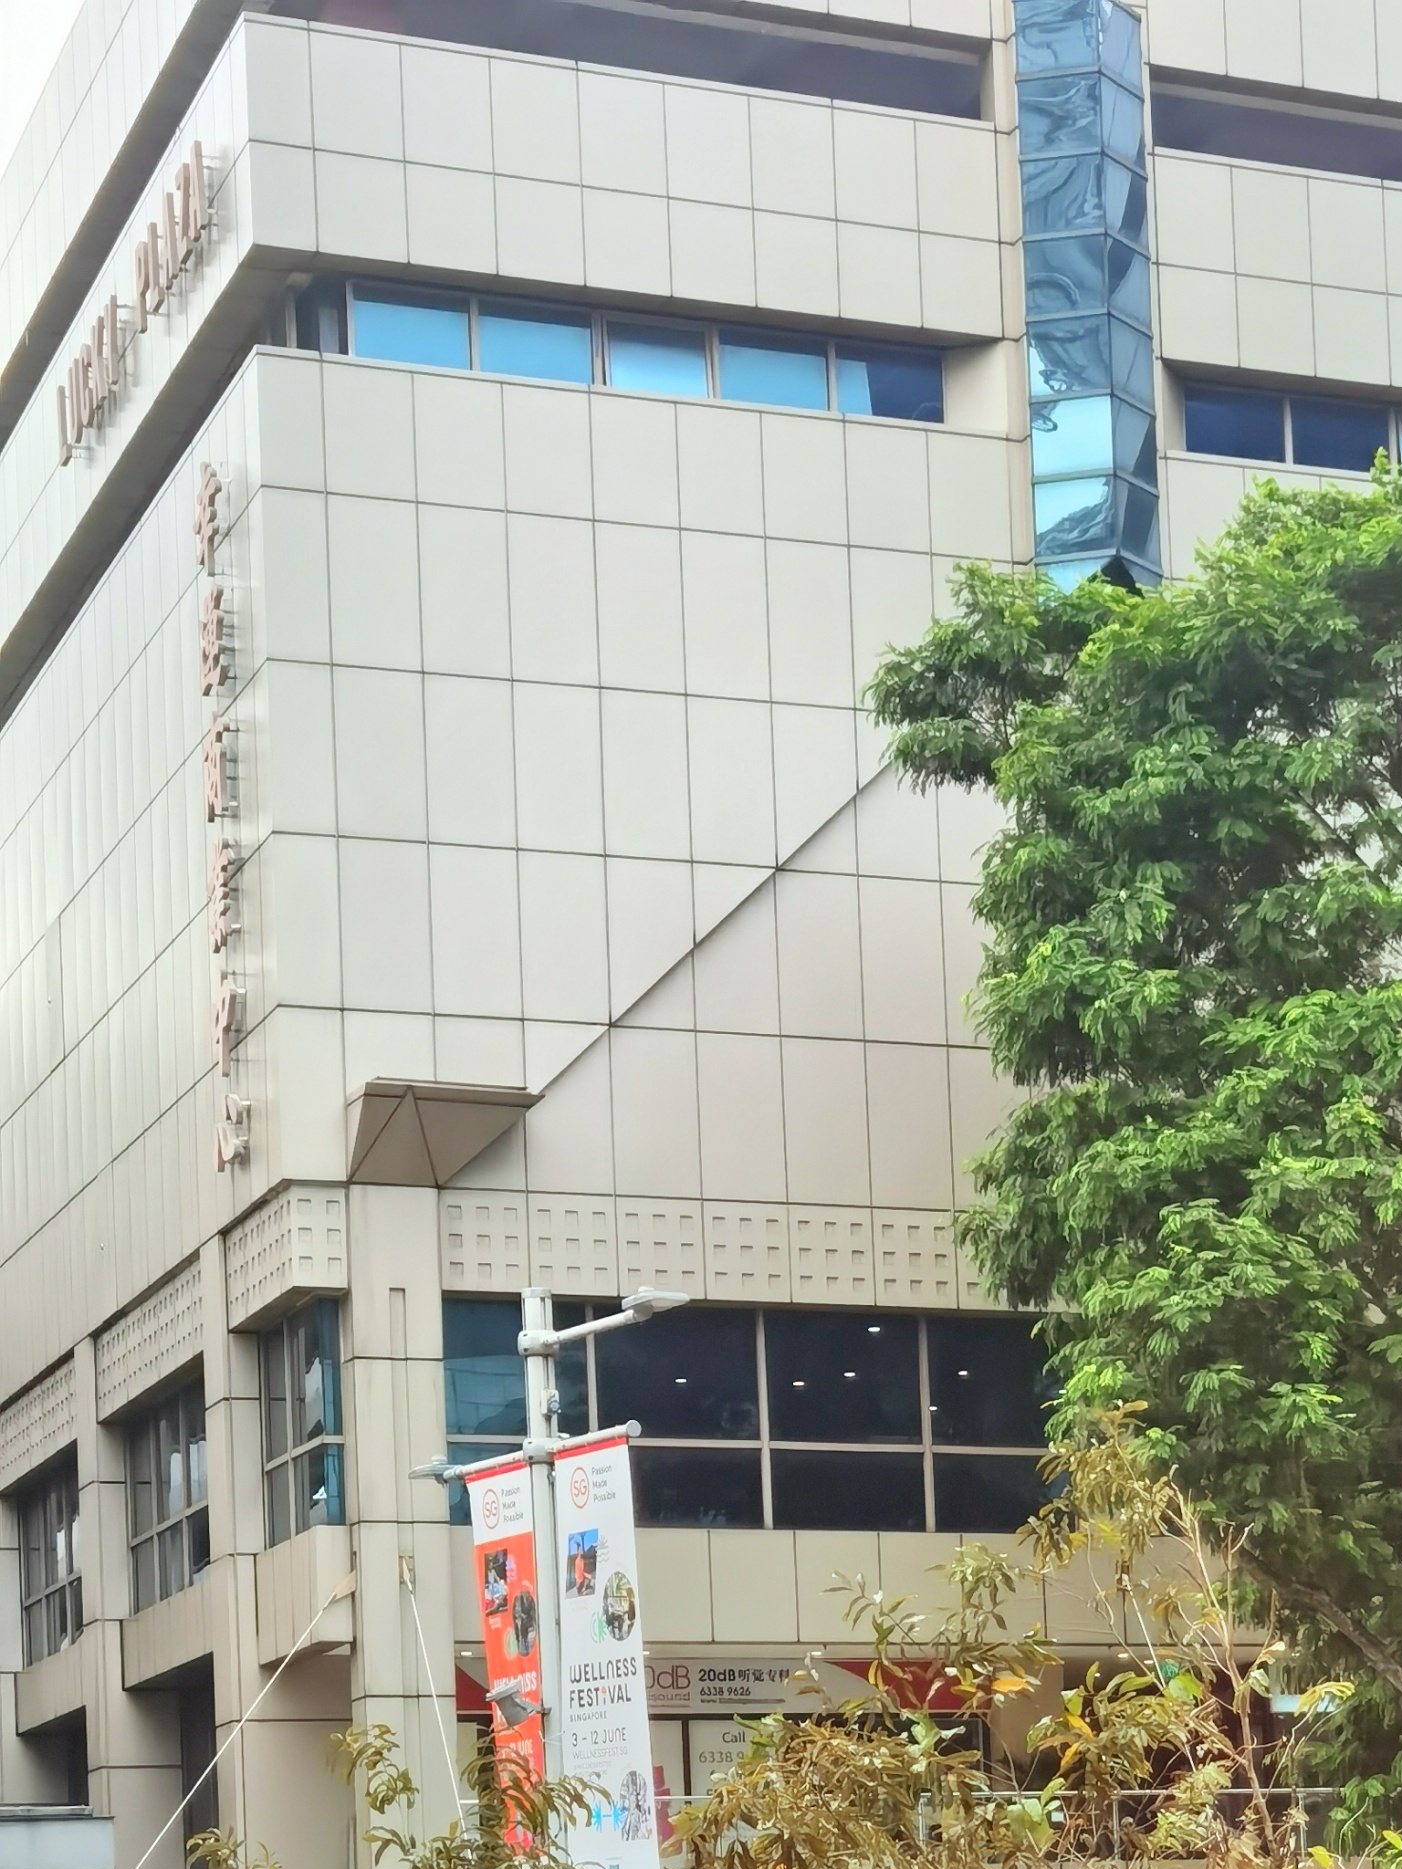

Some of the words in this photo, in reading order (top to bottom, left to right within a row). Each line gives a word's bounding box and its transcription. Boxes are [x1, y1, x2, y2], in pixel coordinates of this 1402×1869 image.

[134, 139, 207, 335] PLAZA
[591, 1465, 613, 1476] Passion
[572, 1479, 588, 1498] SG
[593, 1491, 616, 1503] Possible
[569, 1657, 637, 1684] WELLNESS
[645, 1665, 691, 1690] 0dB
[569, 1683, 632, 1709] FESTIVAL
[700, 1687, 725, 1697] 6338
[727, 1687, 752, 1697] 9626
[569, 1711, 608, 1723] SINGAPORE
[571, 1733, 578, 1747] 3
[590, 1730, 599, 1745] 12
[602, 1727, 627, 1744] JUNE
[722, 1730, 746, 1743] Call
[698, 1751, 733, 1764] 6338
